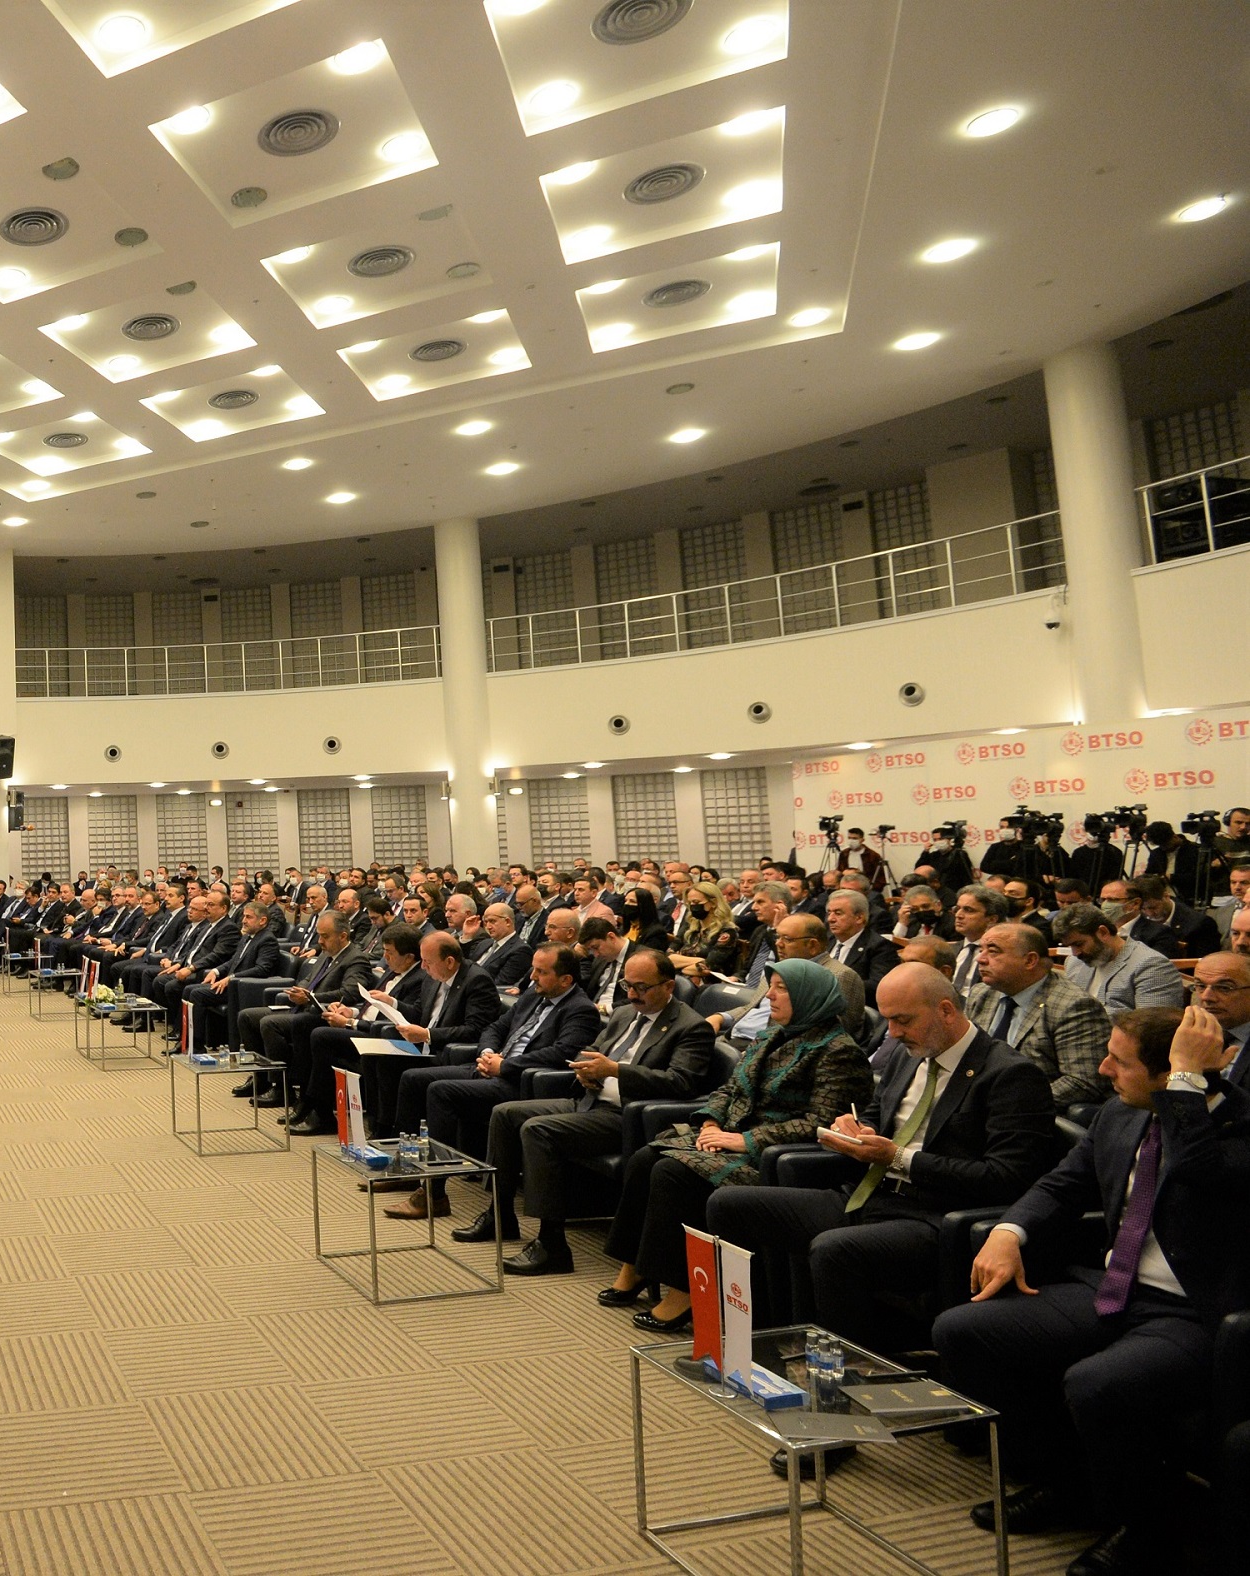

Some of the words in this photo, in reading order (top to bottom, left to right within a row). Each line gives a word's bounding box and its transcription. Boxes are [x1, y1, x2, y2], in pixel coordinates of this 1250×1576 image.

[1218, 720, 1250, 738] BT
[1088, 731, 1144, 749] BTSO
[978, 742, 1026, 759] BTSO
[804, 760, 840, 774] BTSO
[885, 752, 926, 768] BTSO
[1034, 778, 1086, 794] BTSO
[1153, 769, 1215, 788] BTSO
[846, 791, 884, 804] BTSO
[932, 785, 977, 800] BTSO
[809, 833, 845, 846] BTO
[891, 831, 931, 844] BTSO
[726, 1294, 749, 1312] BTSO
